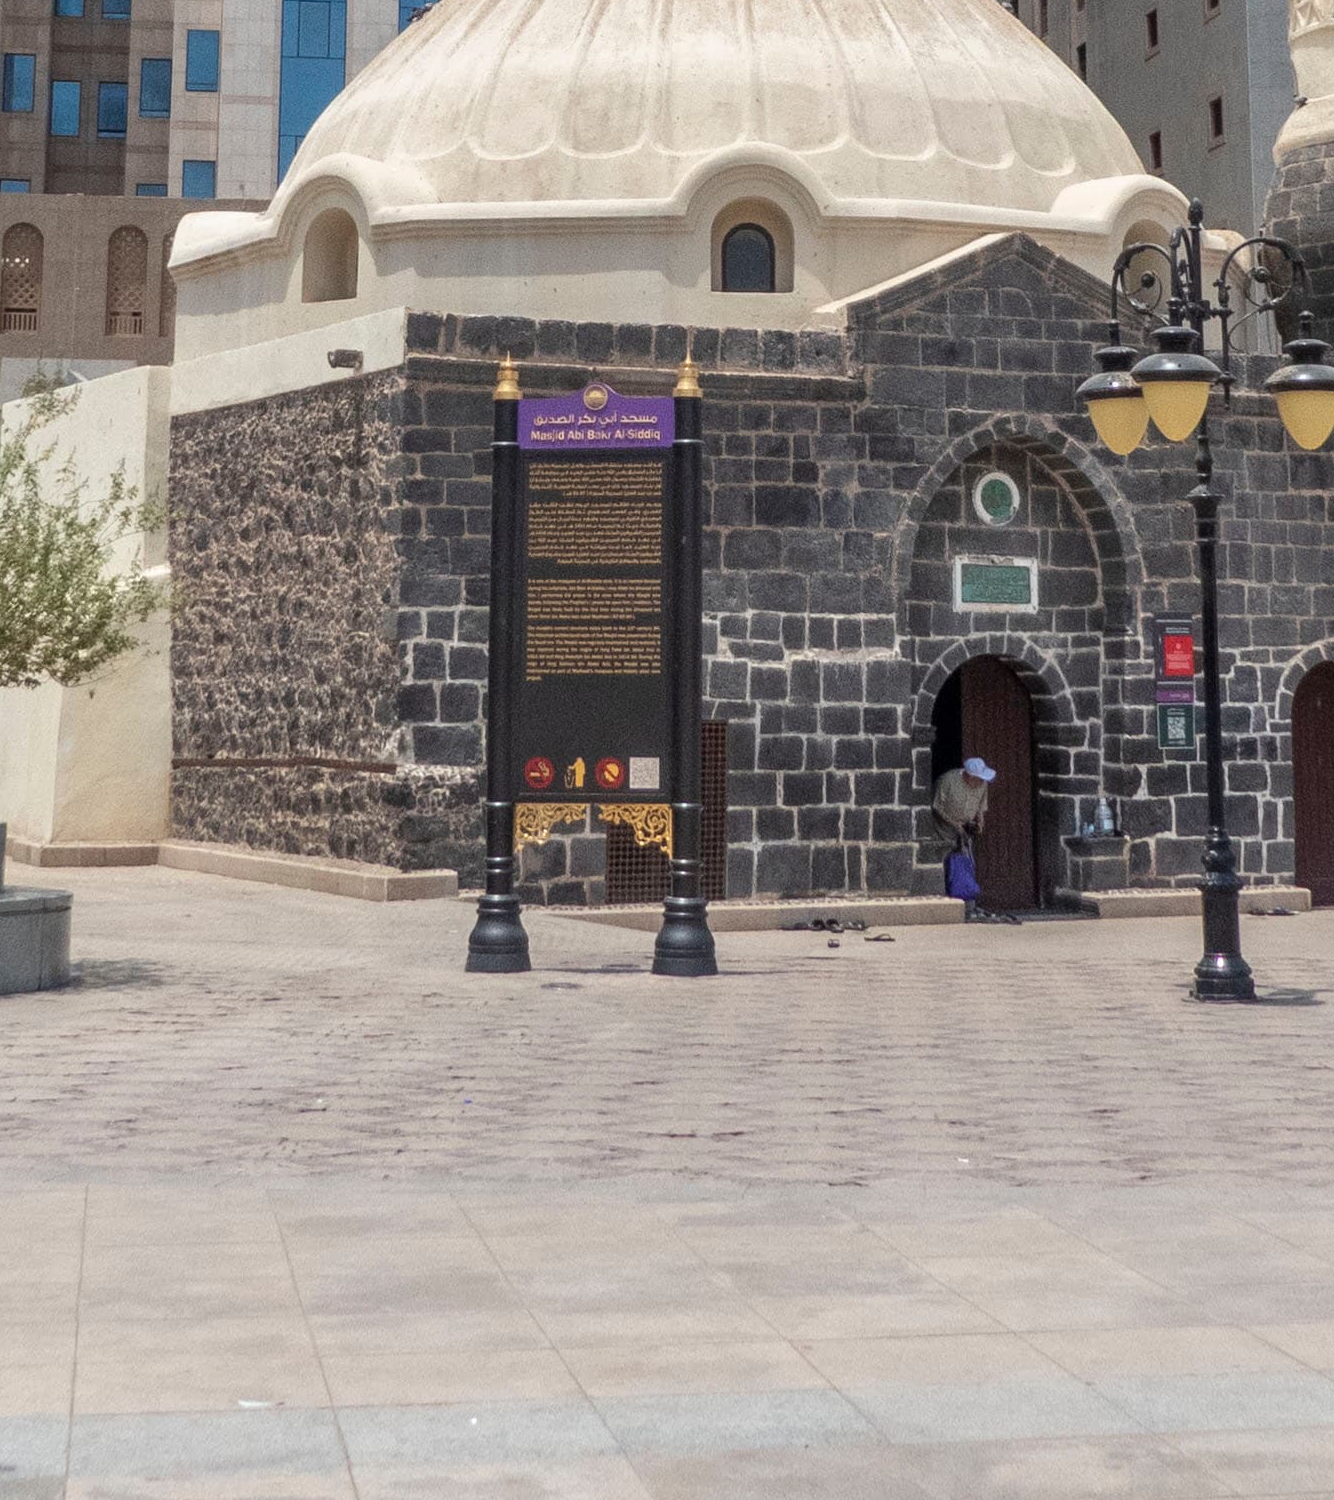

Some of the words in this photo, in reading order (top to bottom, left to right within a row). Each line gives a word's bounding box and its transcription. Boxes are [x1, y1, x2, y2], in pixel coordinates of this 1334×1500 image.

[533, 413, 575, 427] الصديق
[577, 412, 597, 426] بكر
[599, 411, 617, 427] أبي
[620, 414, 658, 424] مسجد
[530, 429, 565, 443] Masjid
[567, 429, 585, 440] Abi
[587, 429, 611, 440] Bakr
[614, 428, 661, 442] Al-Siddiq
